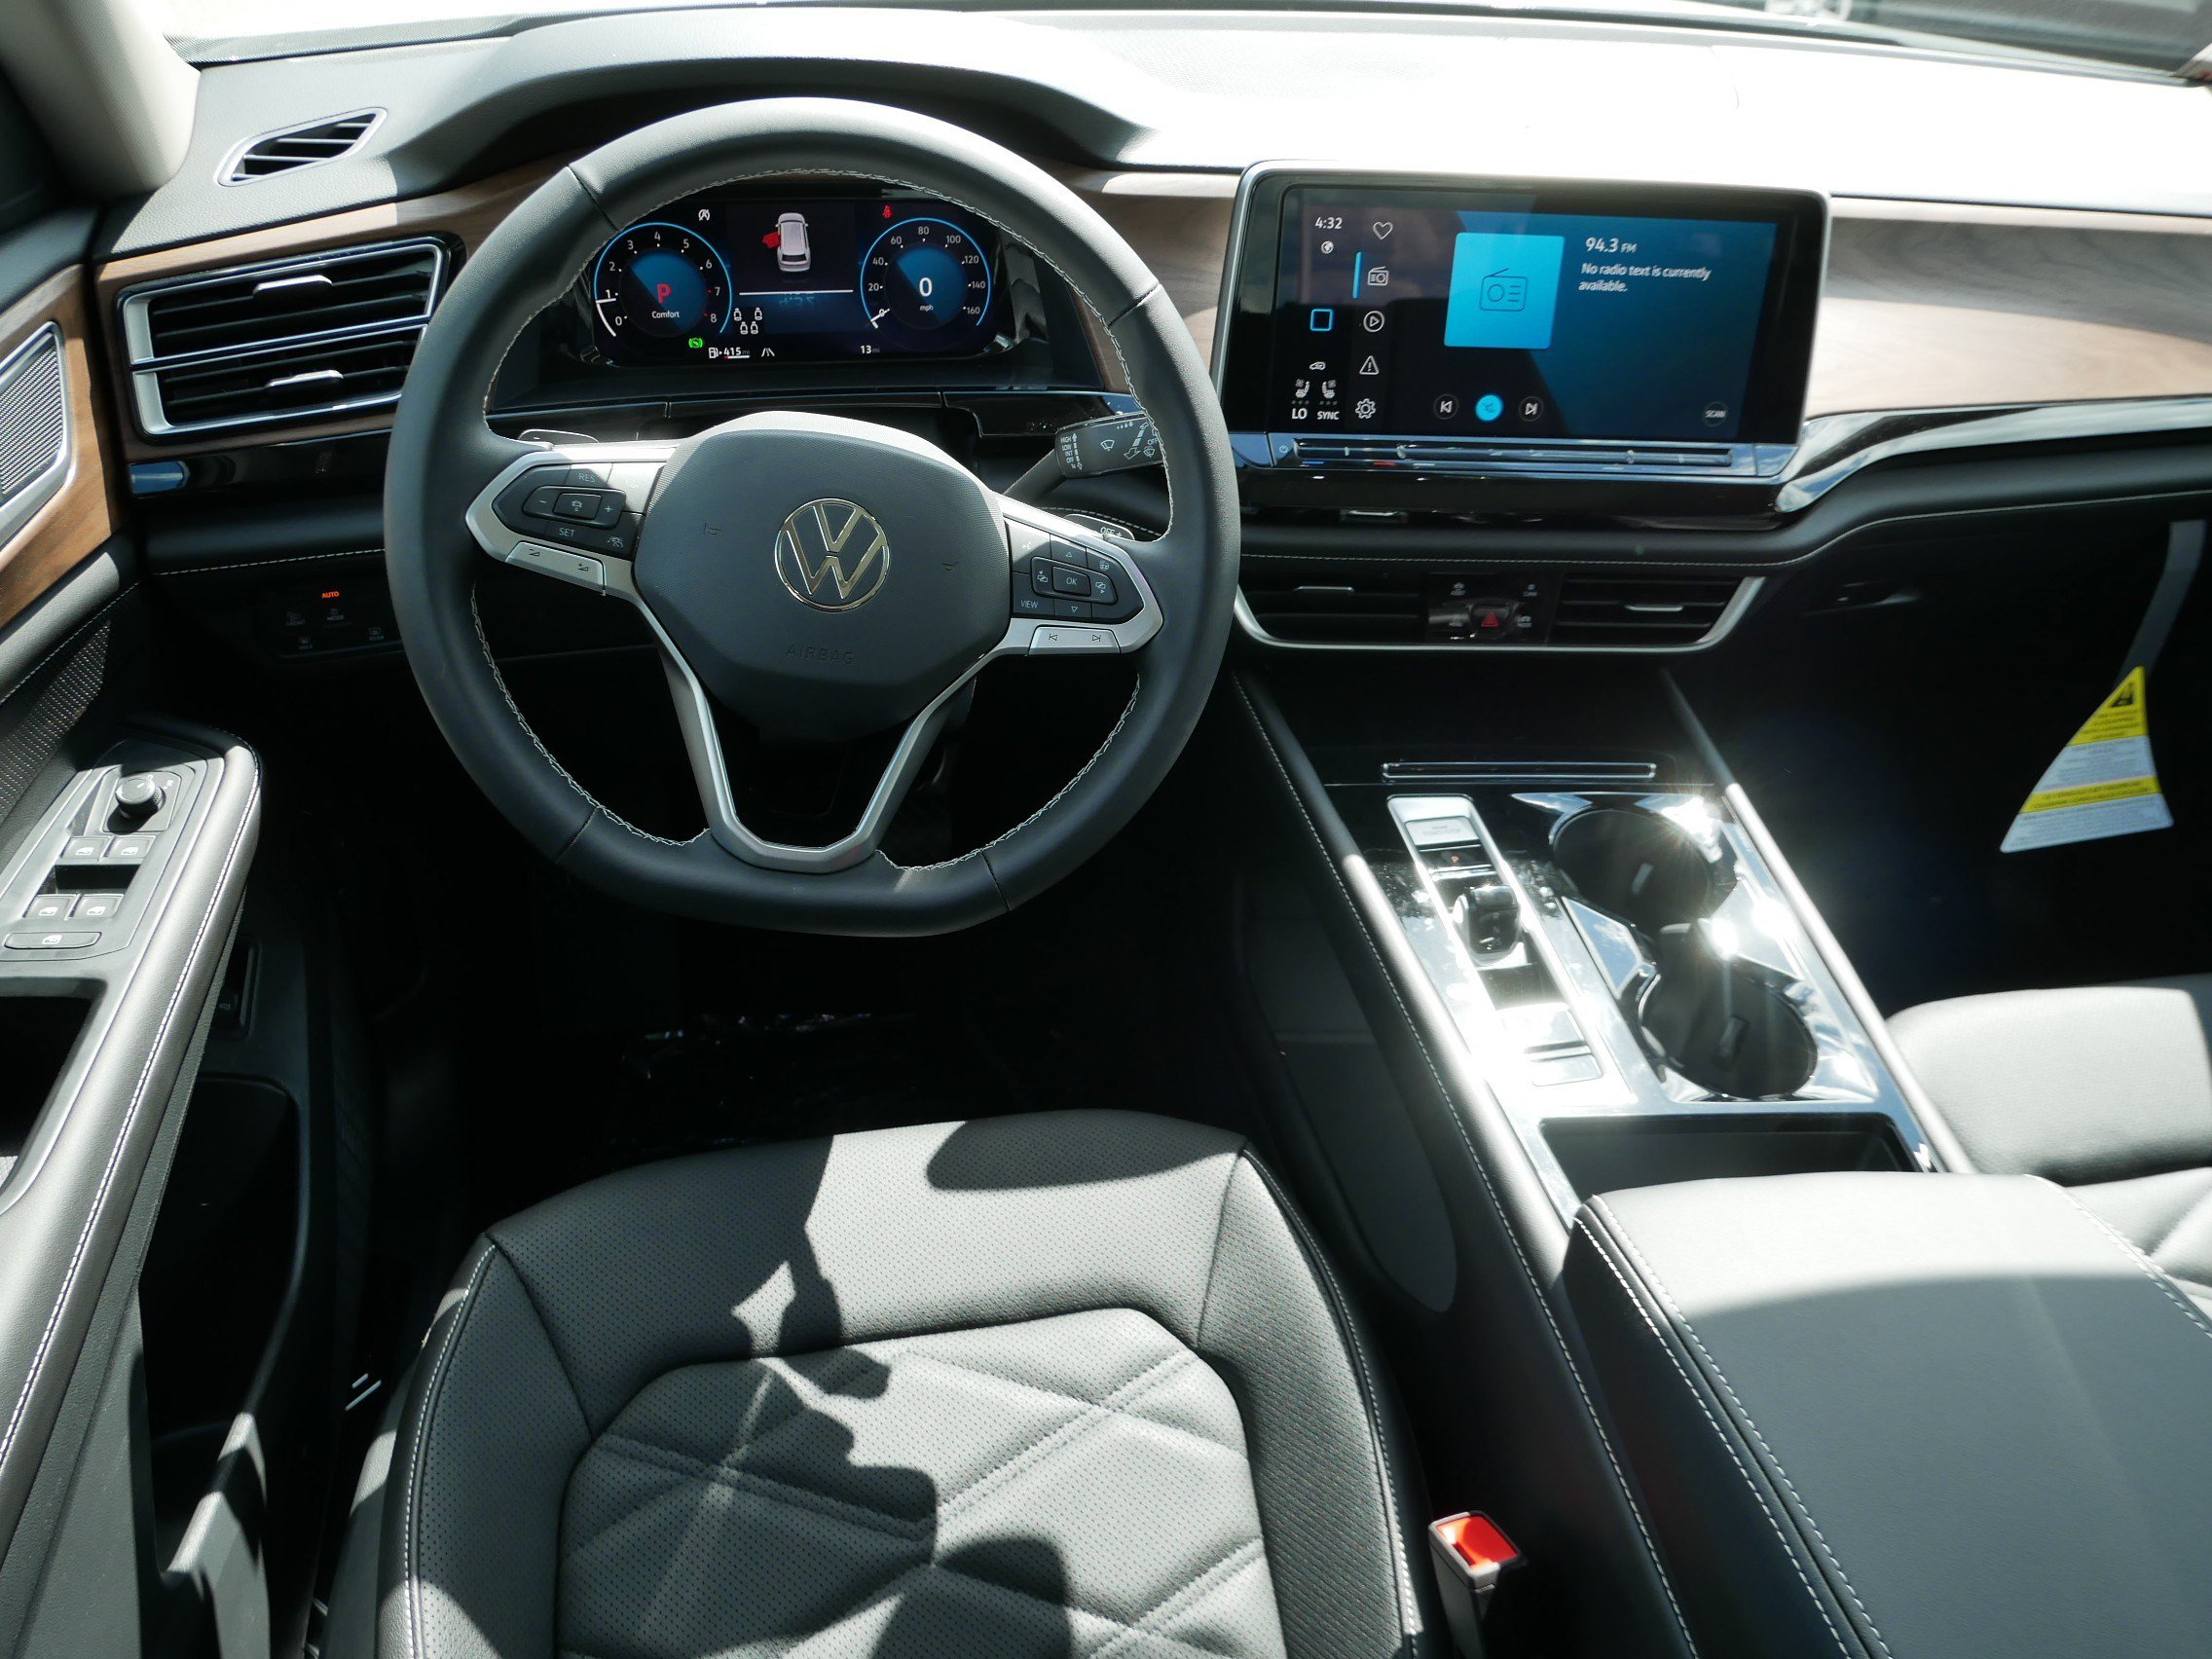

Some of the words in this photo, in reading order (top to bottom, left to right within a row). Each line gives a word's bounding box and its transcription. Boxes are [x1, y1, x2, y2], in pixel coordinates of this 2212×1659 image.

[1314, 217, 1343, 230] 4:32
[654, 231, 661, 240] 4
[918, 226, 929, 235] 80
[682, 239, 689, 248] 5
[890, 236, 902, 244] 60
[945, 235, 961, 243] 100
[627, 240, 634, 250] 3
[1585, 237, 1619, 252] 94.3
[1620, 242, 1638, 253] FM
[705, 259, 713, 269] 6
[872, 257, 884, 266] 40
[963, 255, 979, 264] 120
[608, 261, 615, 272] 2
[1581, 263, 1599, 275] No
[1599, 264, 1627, 276] radio
[1629, 266, 1651, 276] text
[1651, 265, 1662, 276] is
[1662, 267, 1712, 281] currently
[868, 282, 880, 291] 20
[919, 276, 933, 297] 0
[972, 280, 986, 289] 140
[1578, 279, 1628, 292] available.
[656, 283, 672, 304] P
[715, 286, 720, 296] 7
[651, 311, 680, 319] Comfort
[710, 313, 718, 323] 8
[614, 315, 623, 326] 0
[723, 347, 741, 355] 415
[860, 345, 871, 354] 13
[1291, 408, 1308, 420] LO
[1316, 410, 1340, 421] SYNC
[578, 472, 596, 483] RES
[559, 527, 575, 537] SET
[1065, 576, 1077, 585] OK
[321, 590, 340, 599] AUTO
[1020, 599, 1039, 608] VIEW
[786, 644, 856, 664] AIRBAG
